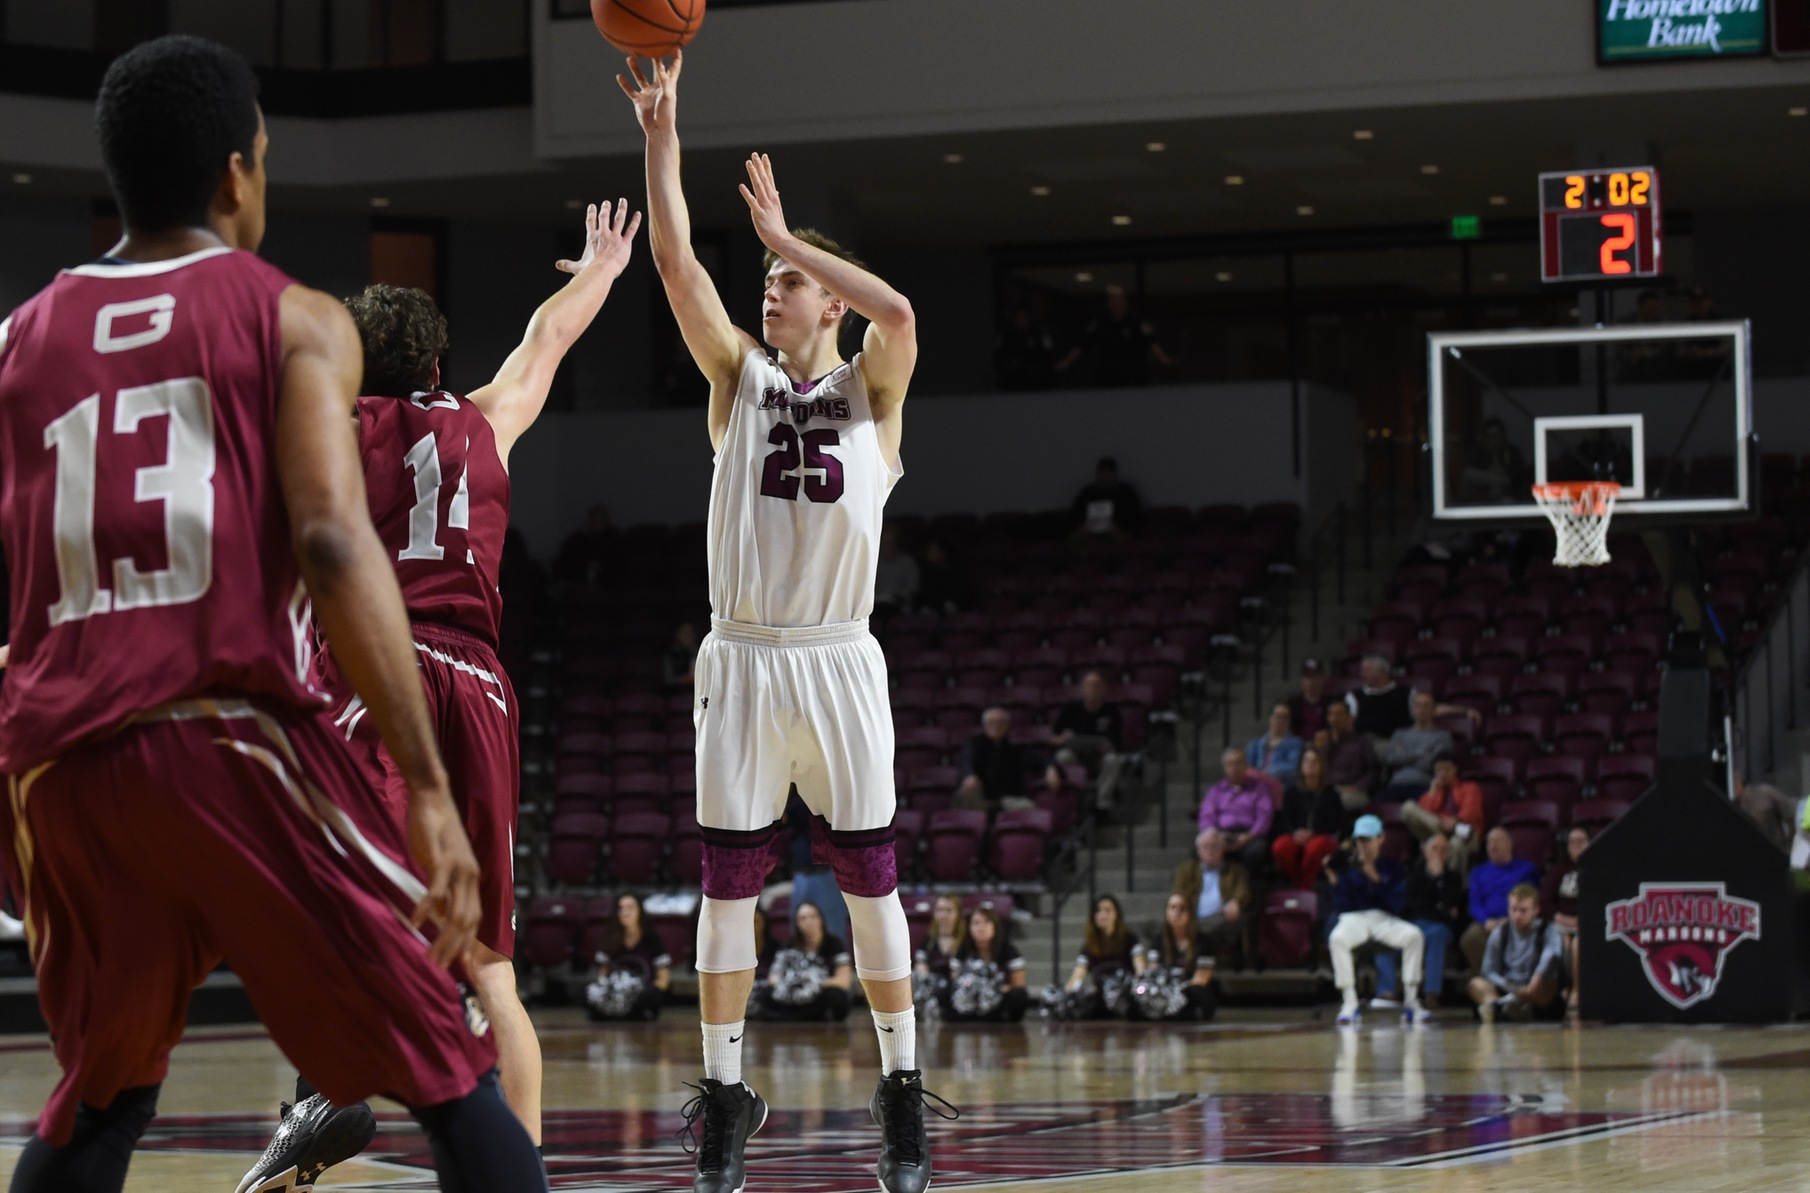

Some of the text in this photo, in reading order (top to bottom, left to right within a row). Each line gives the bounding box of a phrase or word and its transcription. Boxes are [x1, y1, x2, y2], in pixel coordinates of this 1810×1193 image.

[1647, 14, 1722, 53] Bank
[1600, 213, 1635, 274] 2
[93, 293, 176, 354] G
[760, 421, 845, 503] 25
[43, 376, 216, 627] 13
[1609, 894, 1758, 934] ROANOKE
